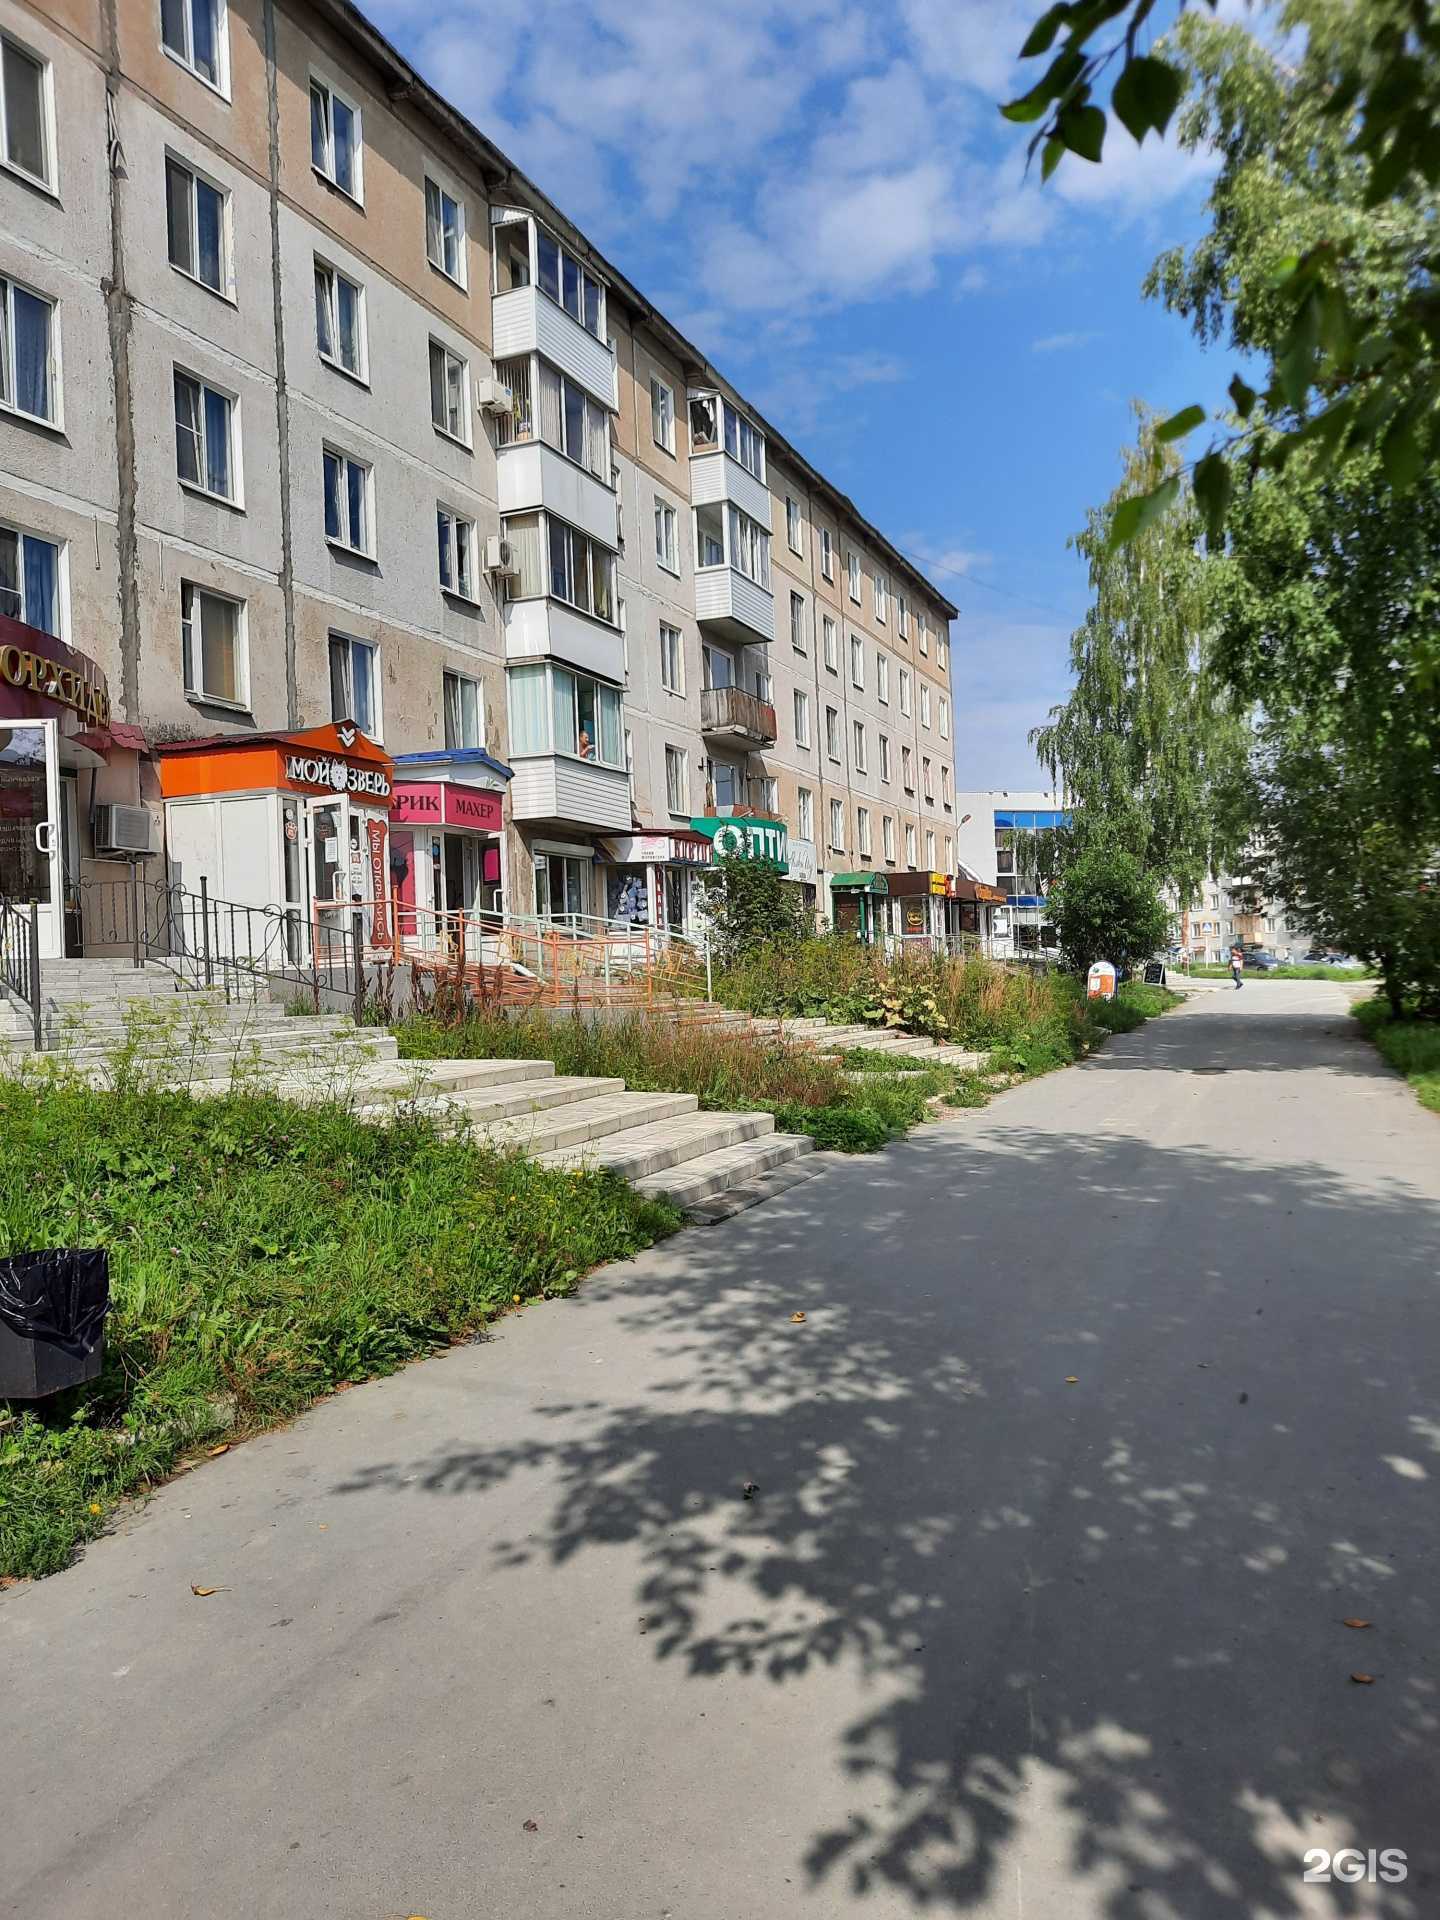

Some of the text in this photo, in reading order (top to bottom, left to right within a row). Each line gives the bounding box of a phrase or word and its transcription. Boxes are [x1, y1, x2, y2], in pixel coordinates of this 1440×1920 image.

[288, 756, 390, 796] МОЙ ЗВЕРЬ
[455, 799, 494, 819] МАХЕР
[372, 829, 381, 853] МЫ
[713, 825, 788, 863] ОПТИ
